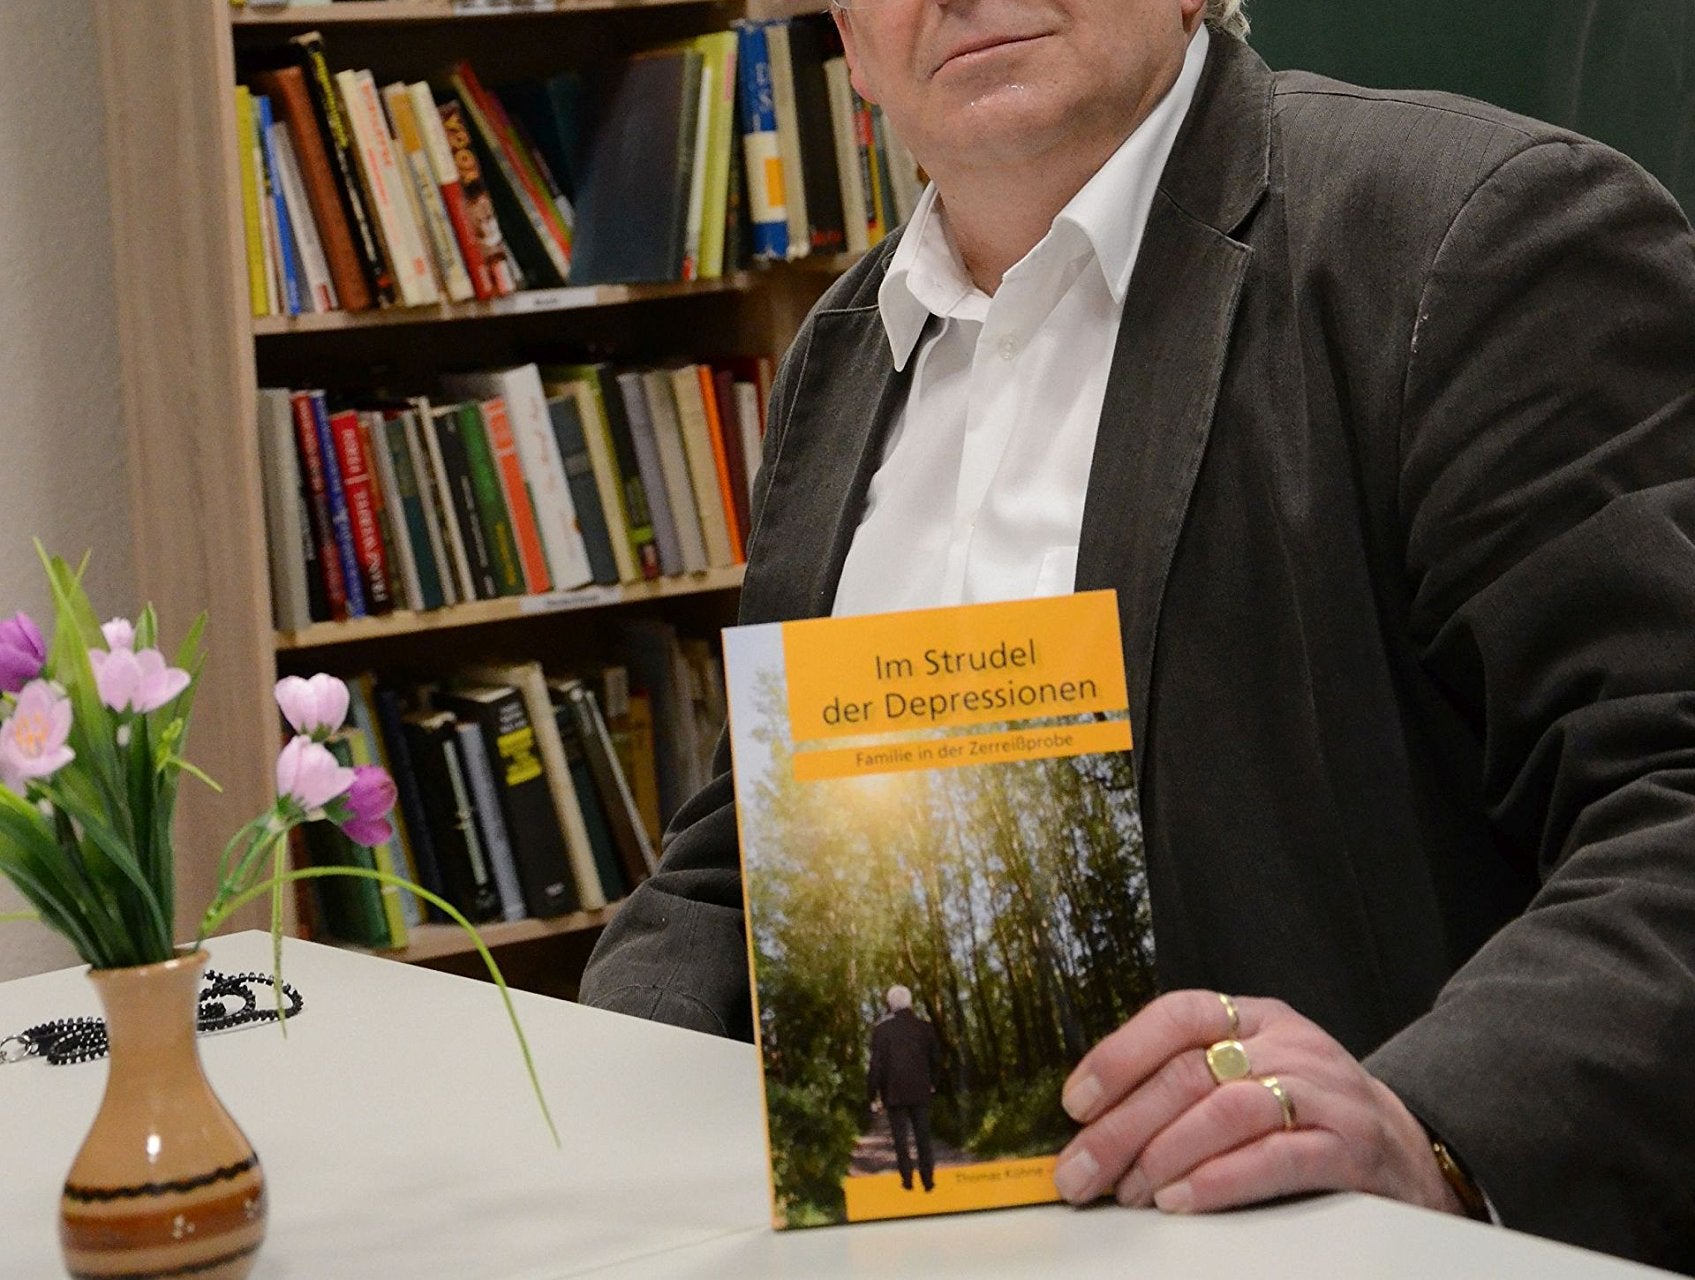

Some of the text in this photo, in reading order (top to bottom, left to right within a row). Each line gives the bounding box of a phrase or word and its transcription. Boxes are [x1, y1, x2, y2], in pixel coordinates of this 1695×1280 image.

[876, 638, 1036, 680] Im Strudel
[822, 679, 1097, 725] der Depressionen
[856, 734, 1074, 767] Familie in der Zerreißprobe
